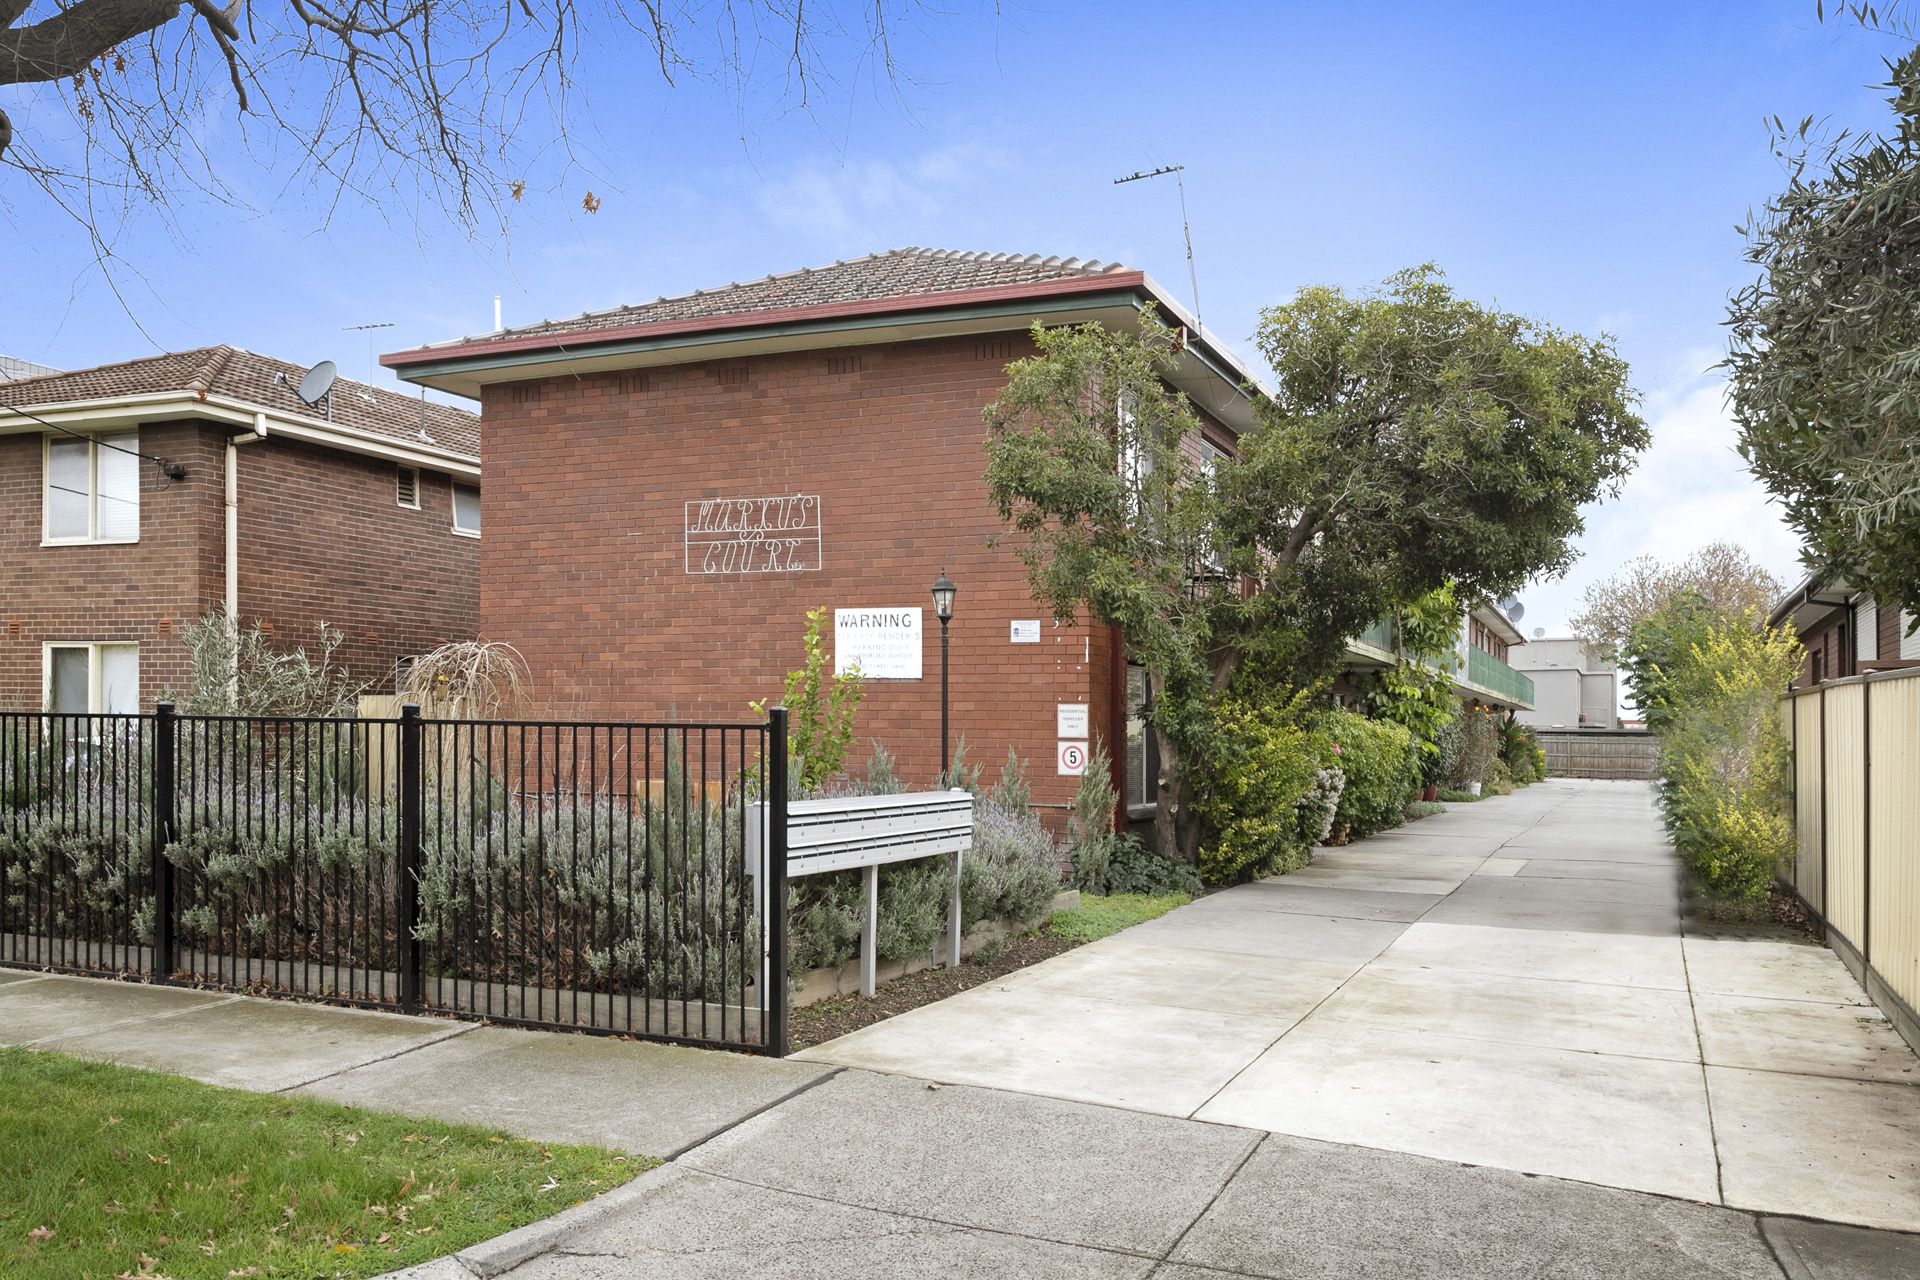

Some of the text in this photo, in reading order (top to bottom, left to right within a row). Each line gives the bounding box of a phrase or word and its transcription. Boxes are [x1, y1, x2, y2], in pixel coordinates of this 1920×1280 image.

[838, 613, 912, 628] WARNING
[878, 631, 920, 640] RESIDENS
[1069, 750, 1077, 764] 5
